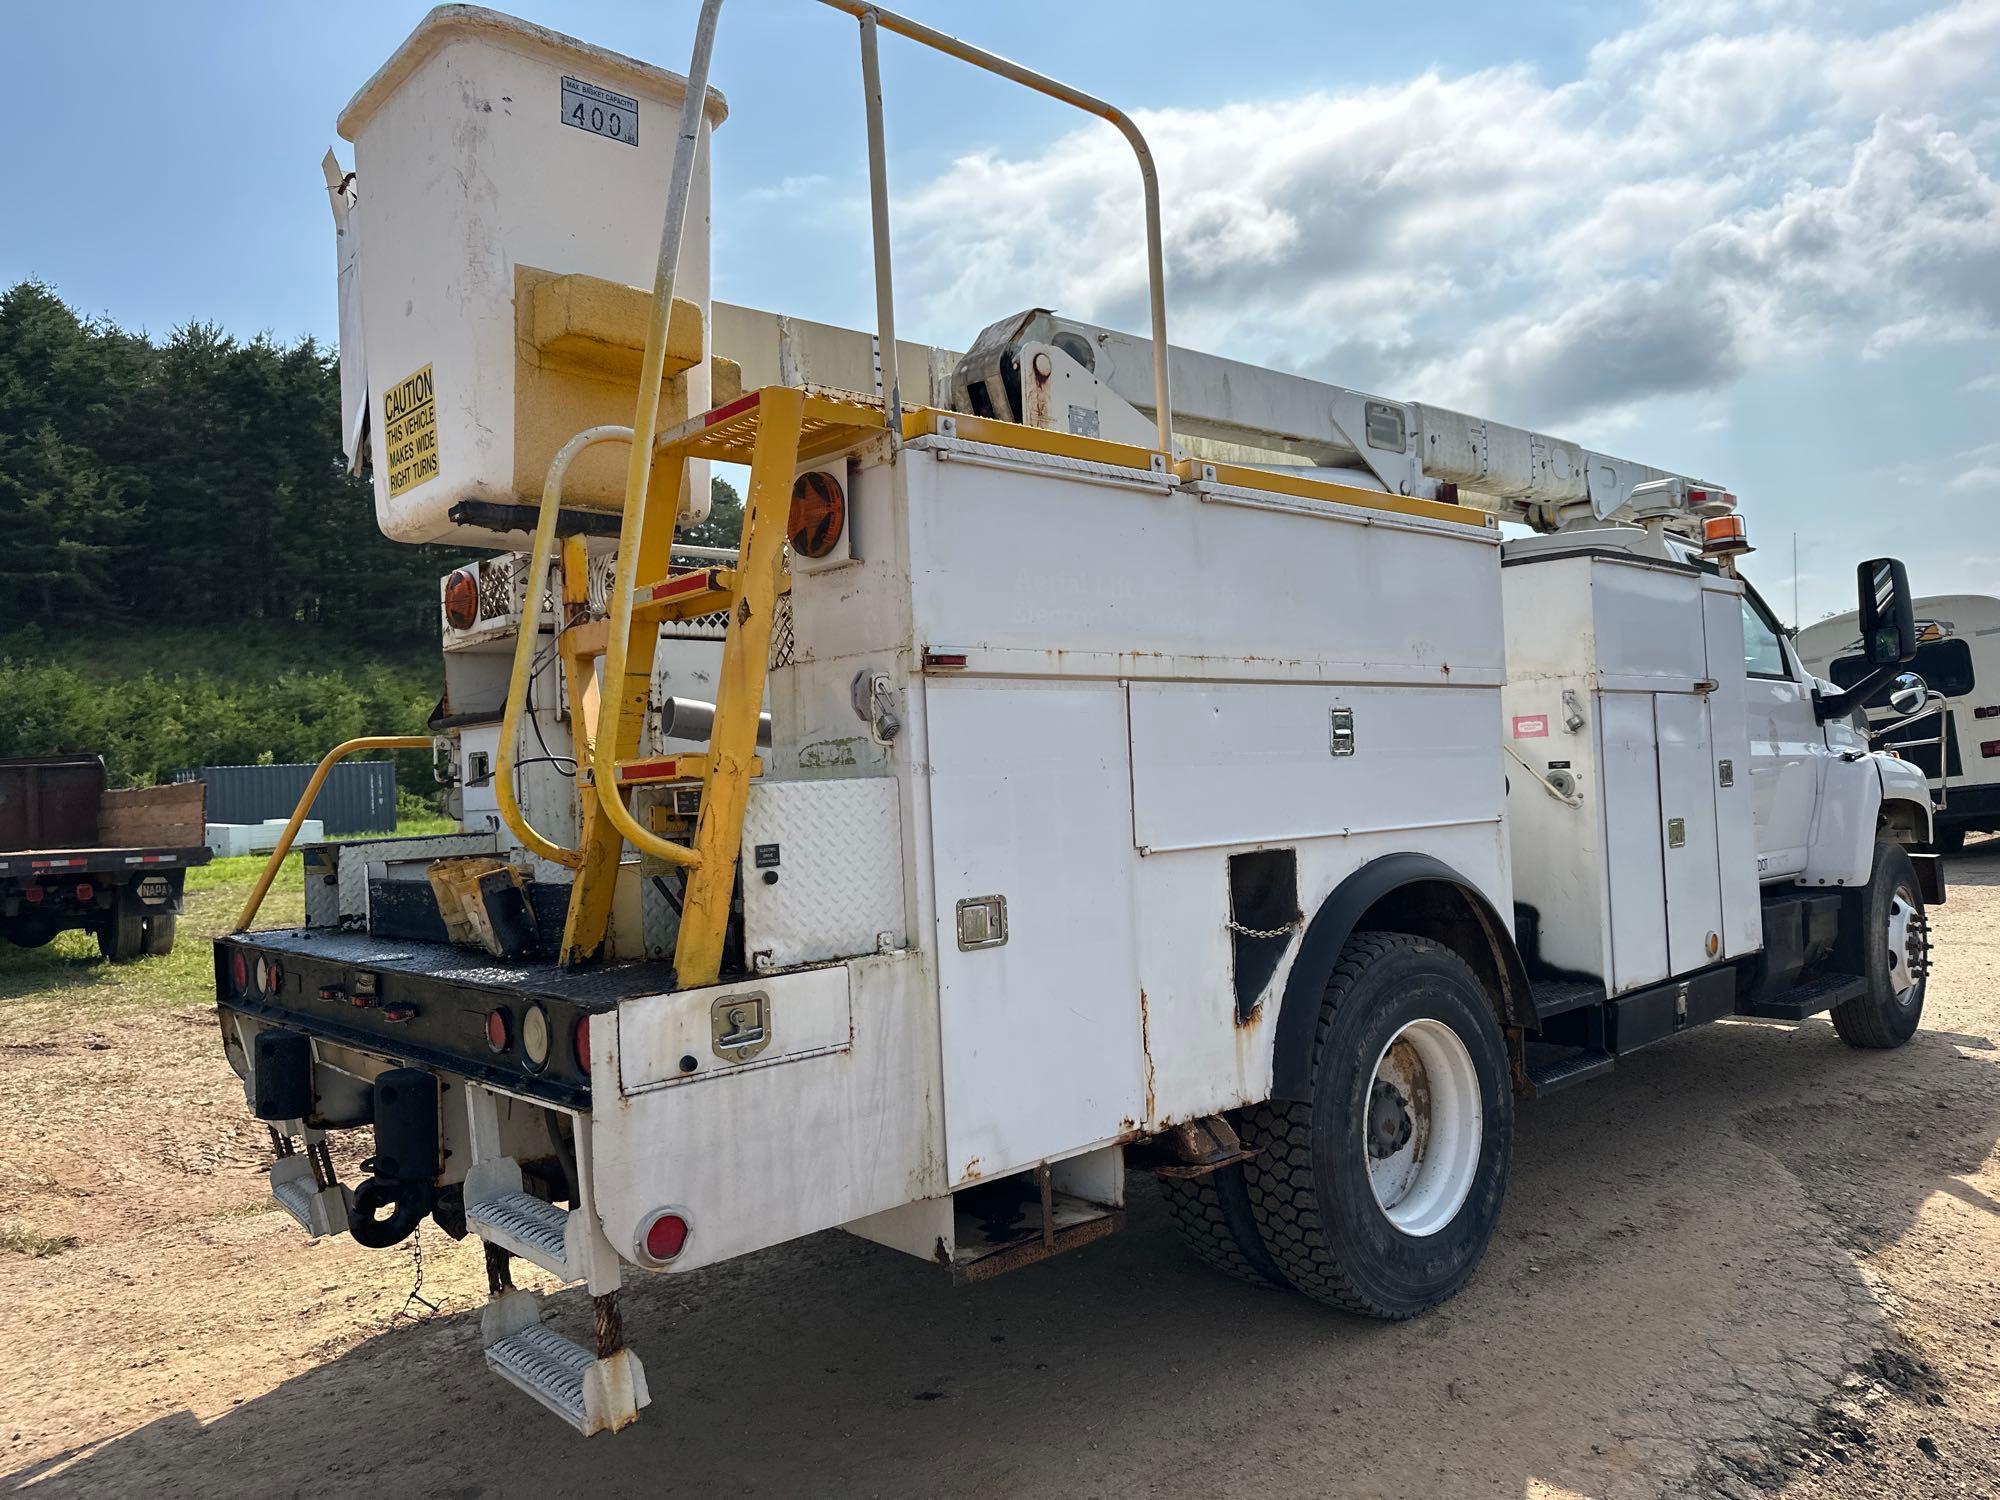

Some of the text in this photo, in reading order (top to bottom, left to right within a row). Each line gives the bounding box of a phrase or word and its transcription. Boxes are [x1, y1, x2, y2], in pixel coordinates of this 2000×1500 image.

[582, 86, 604, 101] BASKET
[605, 93, 634, 109] CAPACITY
[572, 103, 621, 137] 400
[624, 134, 636, 144] LBS
[385, 369, 433, 421] CAUTION
[387, 406, 435, 448] THIS VEHICLE
[389, 430, 435, 469] MAKES WIDE
[390, 453, 437, 492] RIGHT TURNS
[142, 884, 168, 897] NAPA
